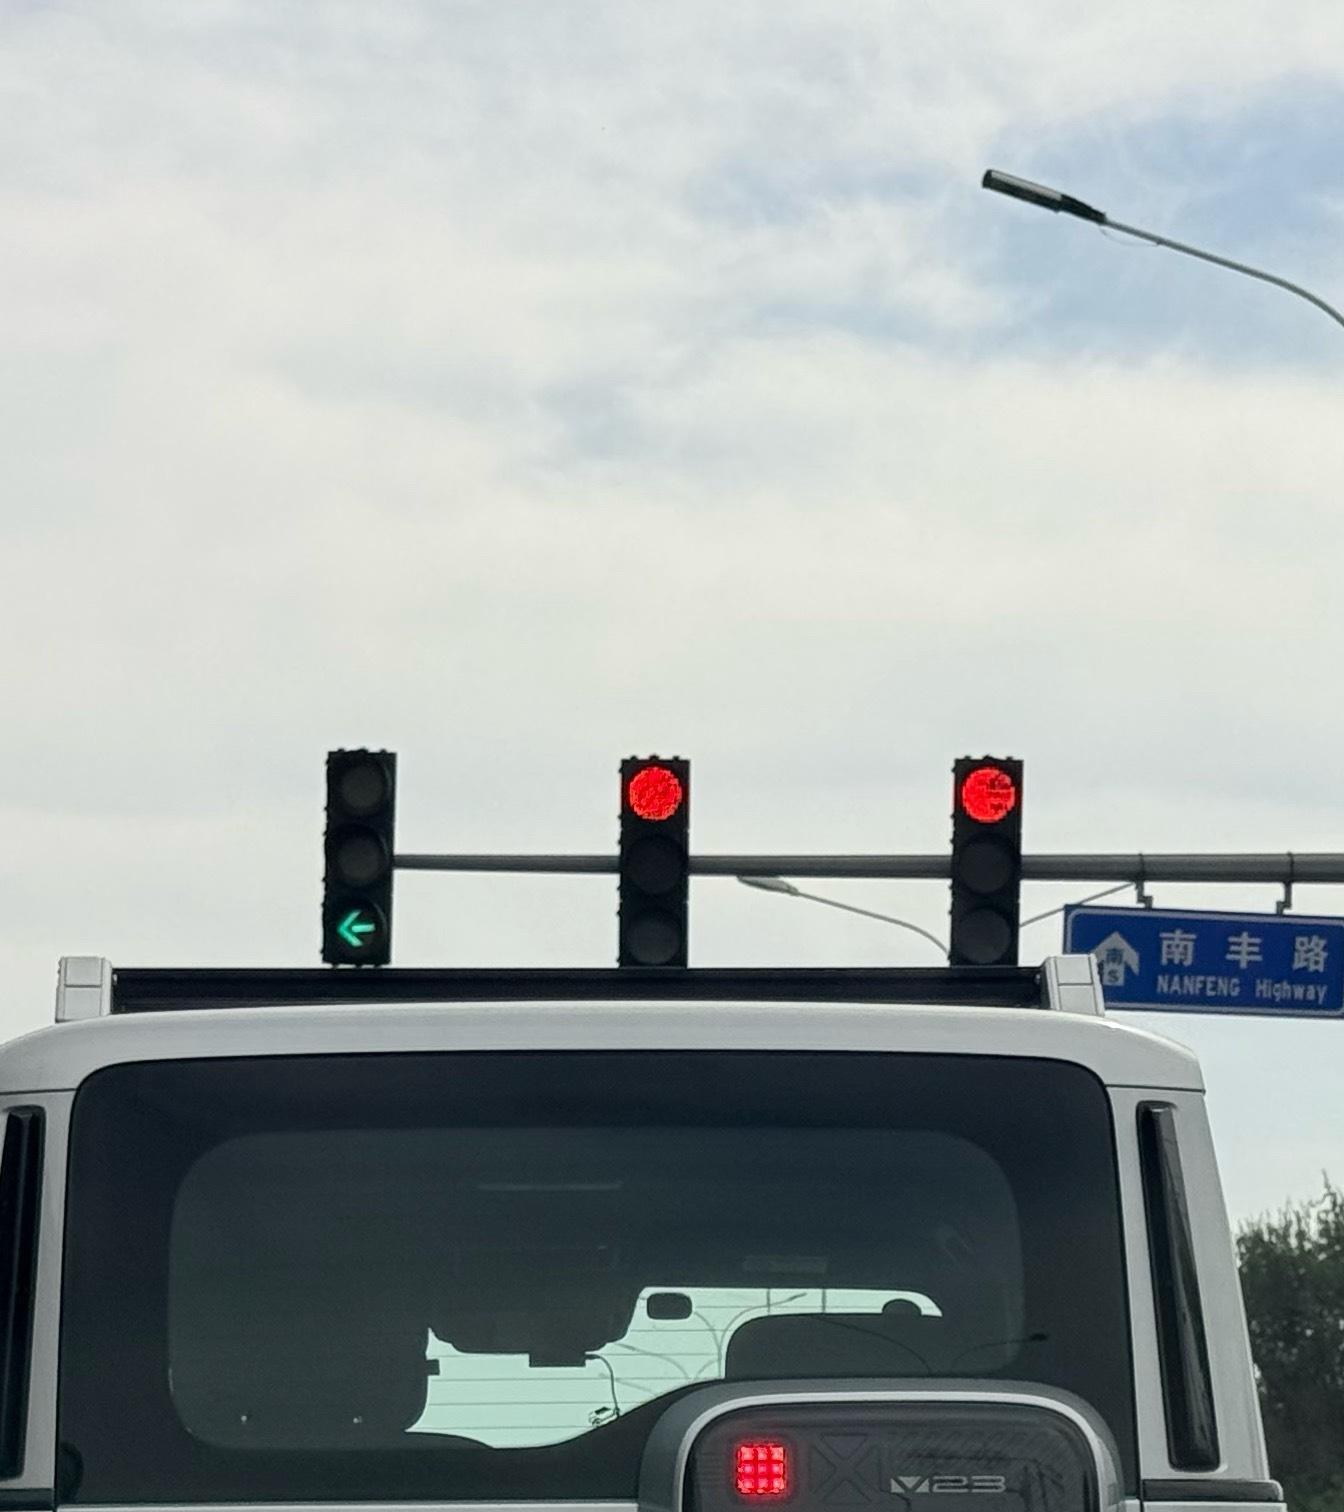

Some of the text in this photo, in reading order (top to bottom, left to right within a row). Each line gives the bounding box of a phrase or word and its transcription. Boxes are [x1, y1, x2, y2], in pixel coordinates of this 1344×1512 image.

[1158, 929, 1329, 973] 南丰路
[1156, 975, 1328, 1004] NANFENG Highway
